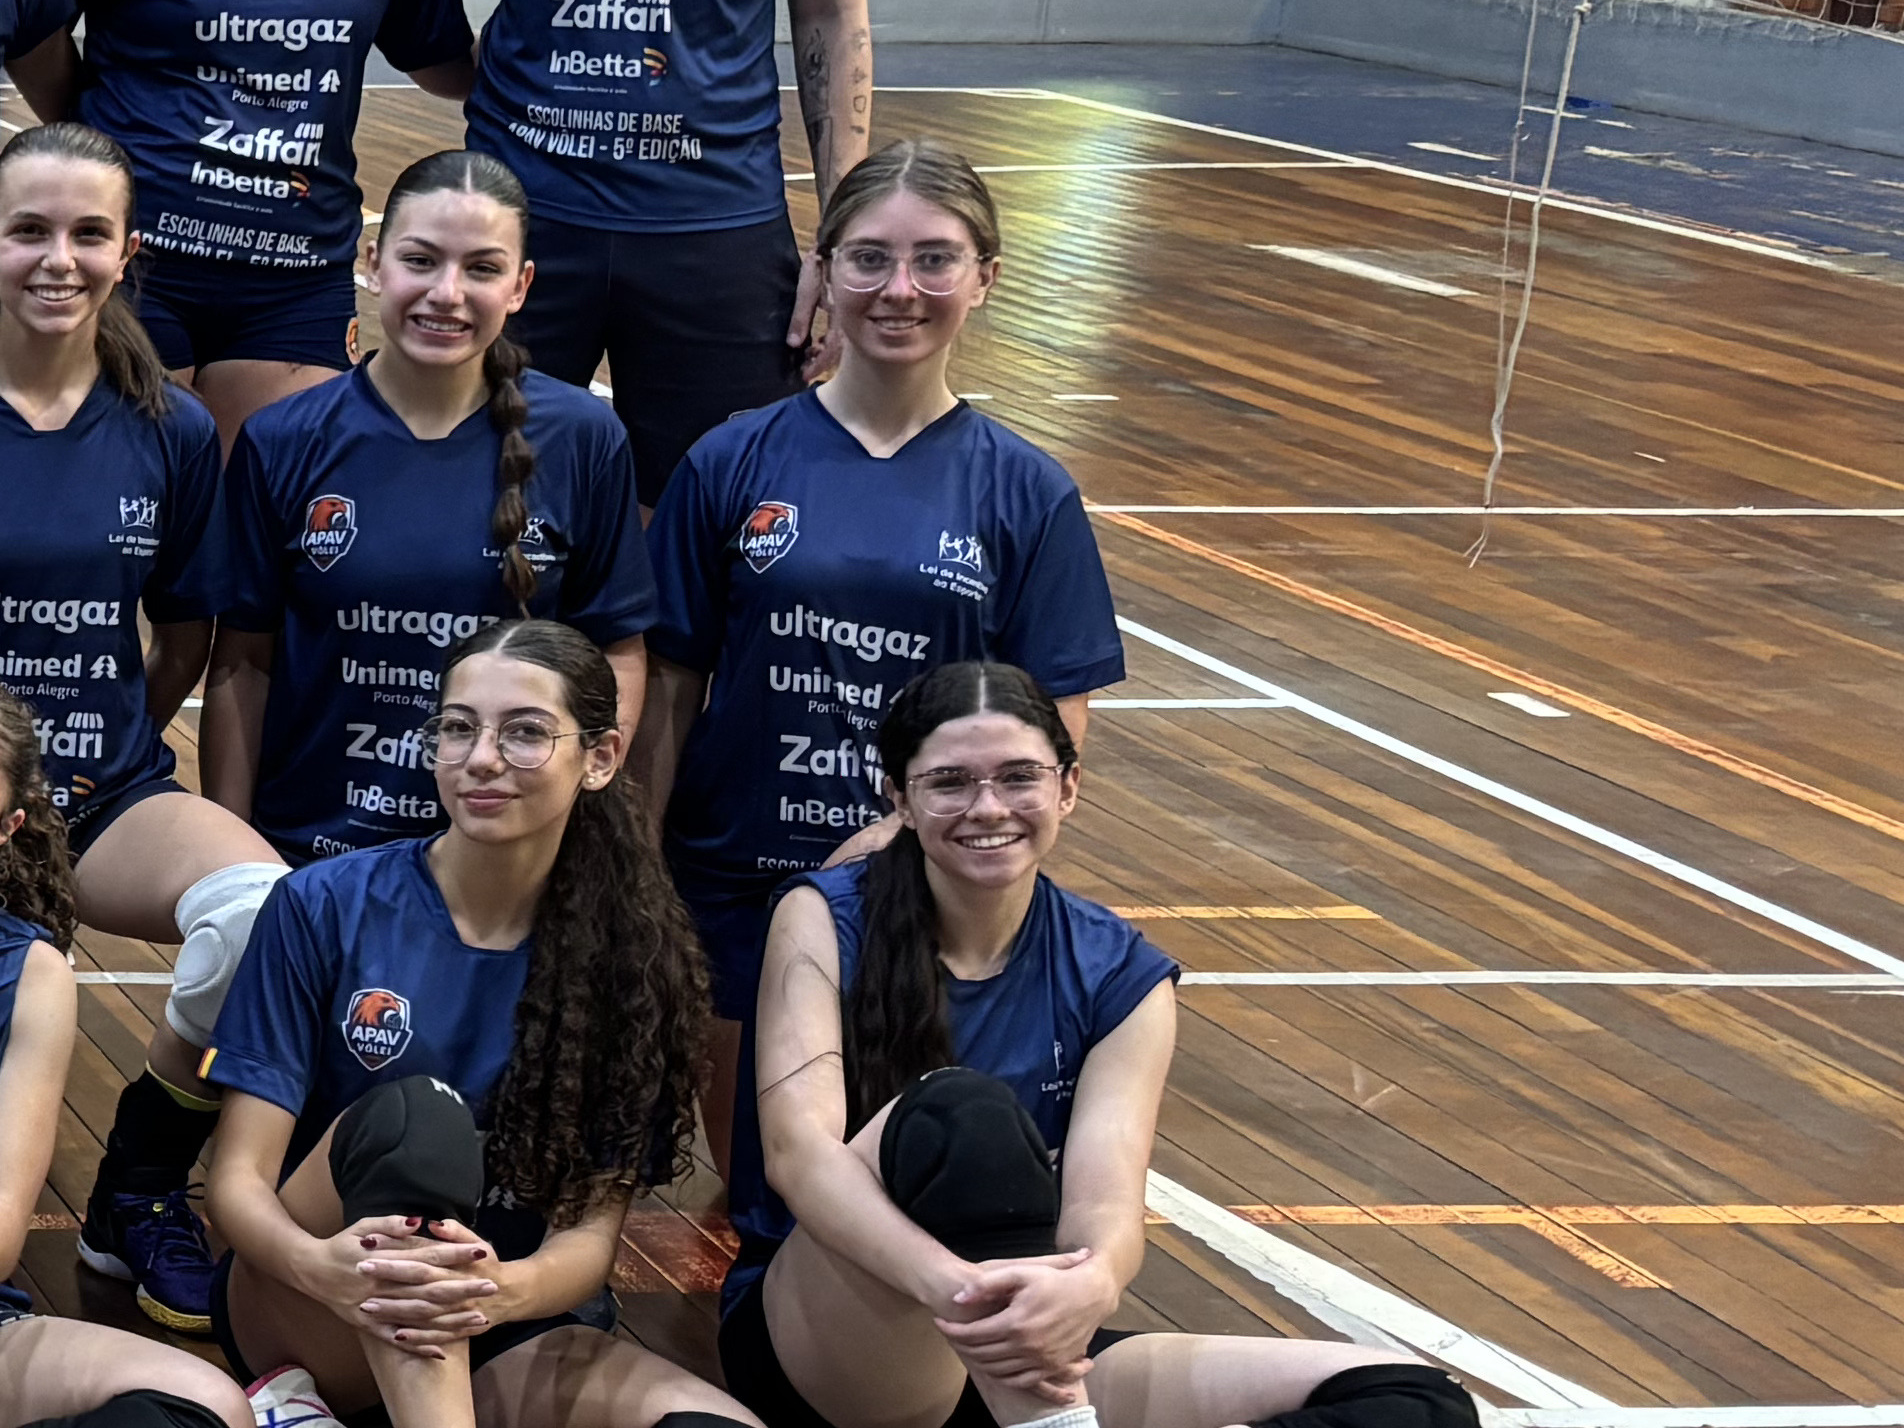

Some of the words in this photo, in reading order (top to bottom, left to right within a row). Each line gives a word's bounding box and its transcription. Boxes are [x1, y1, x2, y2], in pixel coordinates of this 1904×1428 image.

[195, 12, 353, 51] ultragaz
[550, 50, 641, 78] InBetta
[267, 96, 308, 112] Alegre
[528, 104, 613, 131] ESCOLINHAS
[618, 113, 637, 132] DE
[642, 114, 682, 134] BASE
[199, 116, 323, 167] Zaffari
[191, 161, 290, 198] InBetta
[158, 212, 254, 250] ESCOLINHAS
[256, 232, 274, 251] DE
[306, 530, 346, 545] APAV
[745, 534, 788, 550] APAV
[770, 605, 930, 662] ultragaz
[38, 683, 79, 700] Alegre
[373, 692, 409, 705] Porto
[346, 781, 437, 818] InBetta
[351, 1025, 402, 1047] APAV
[357, 1043, 393, 1056] VÔLEI
